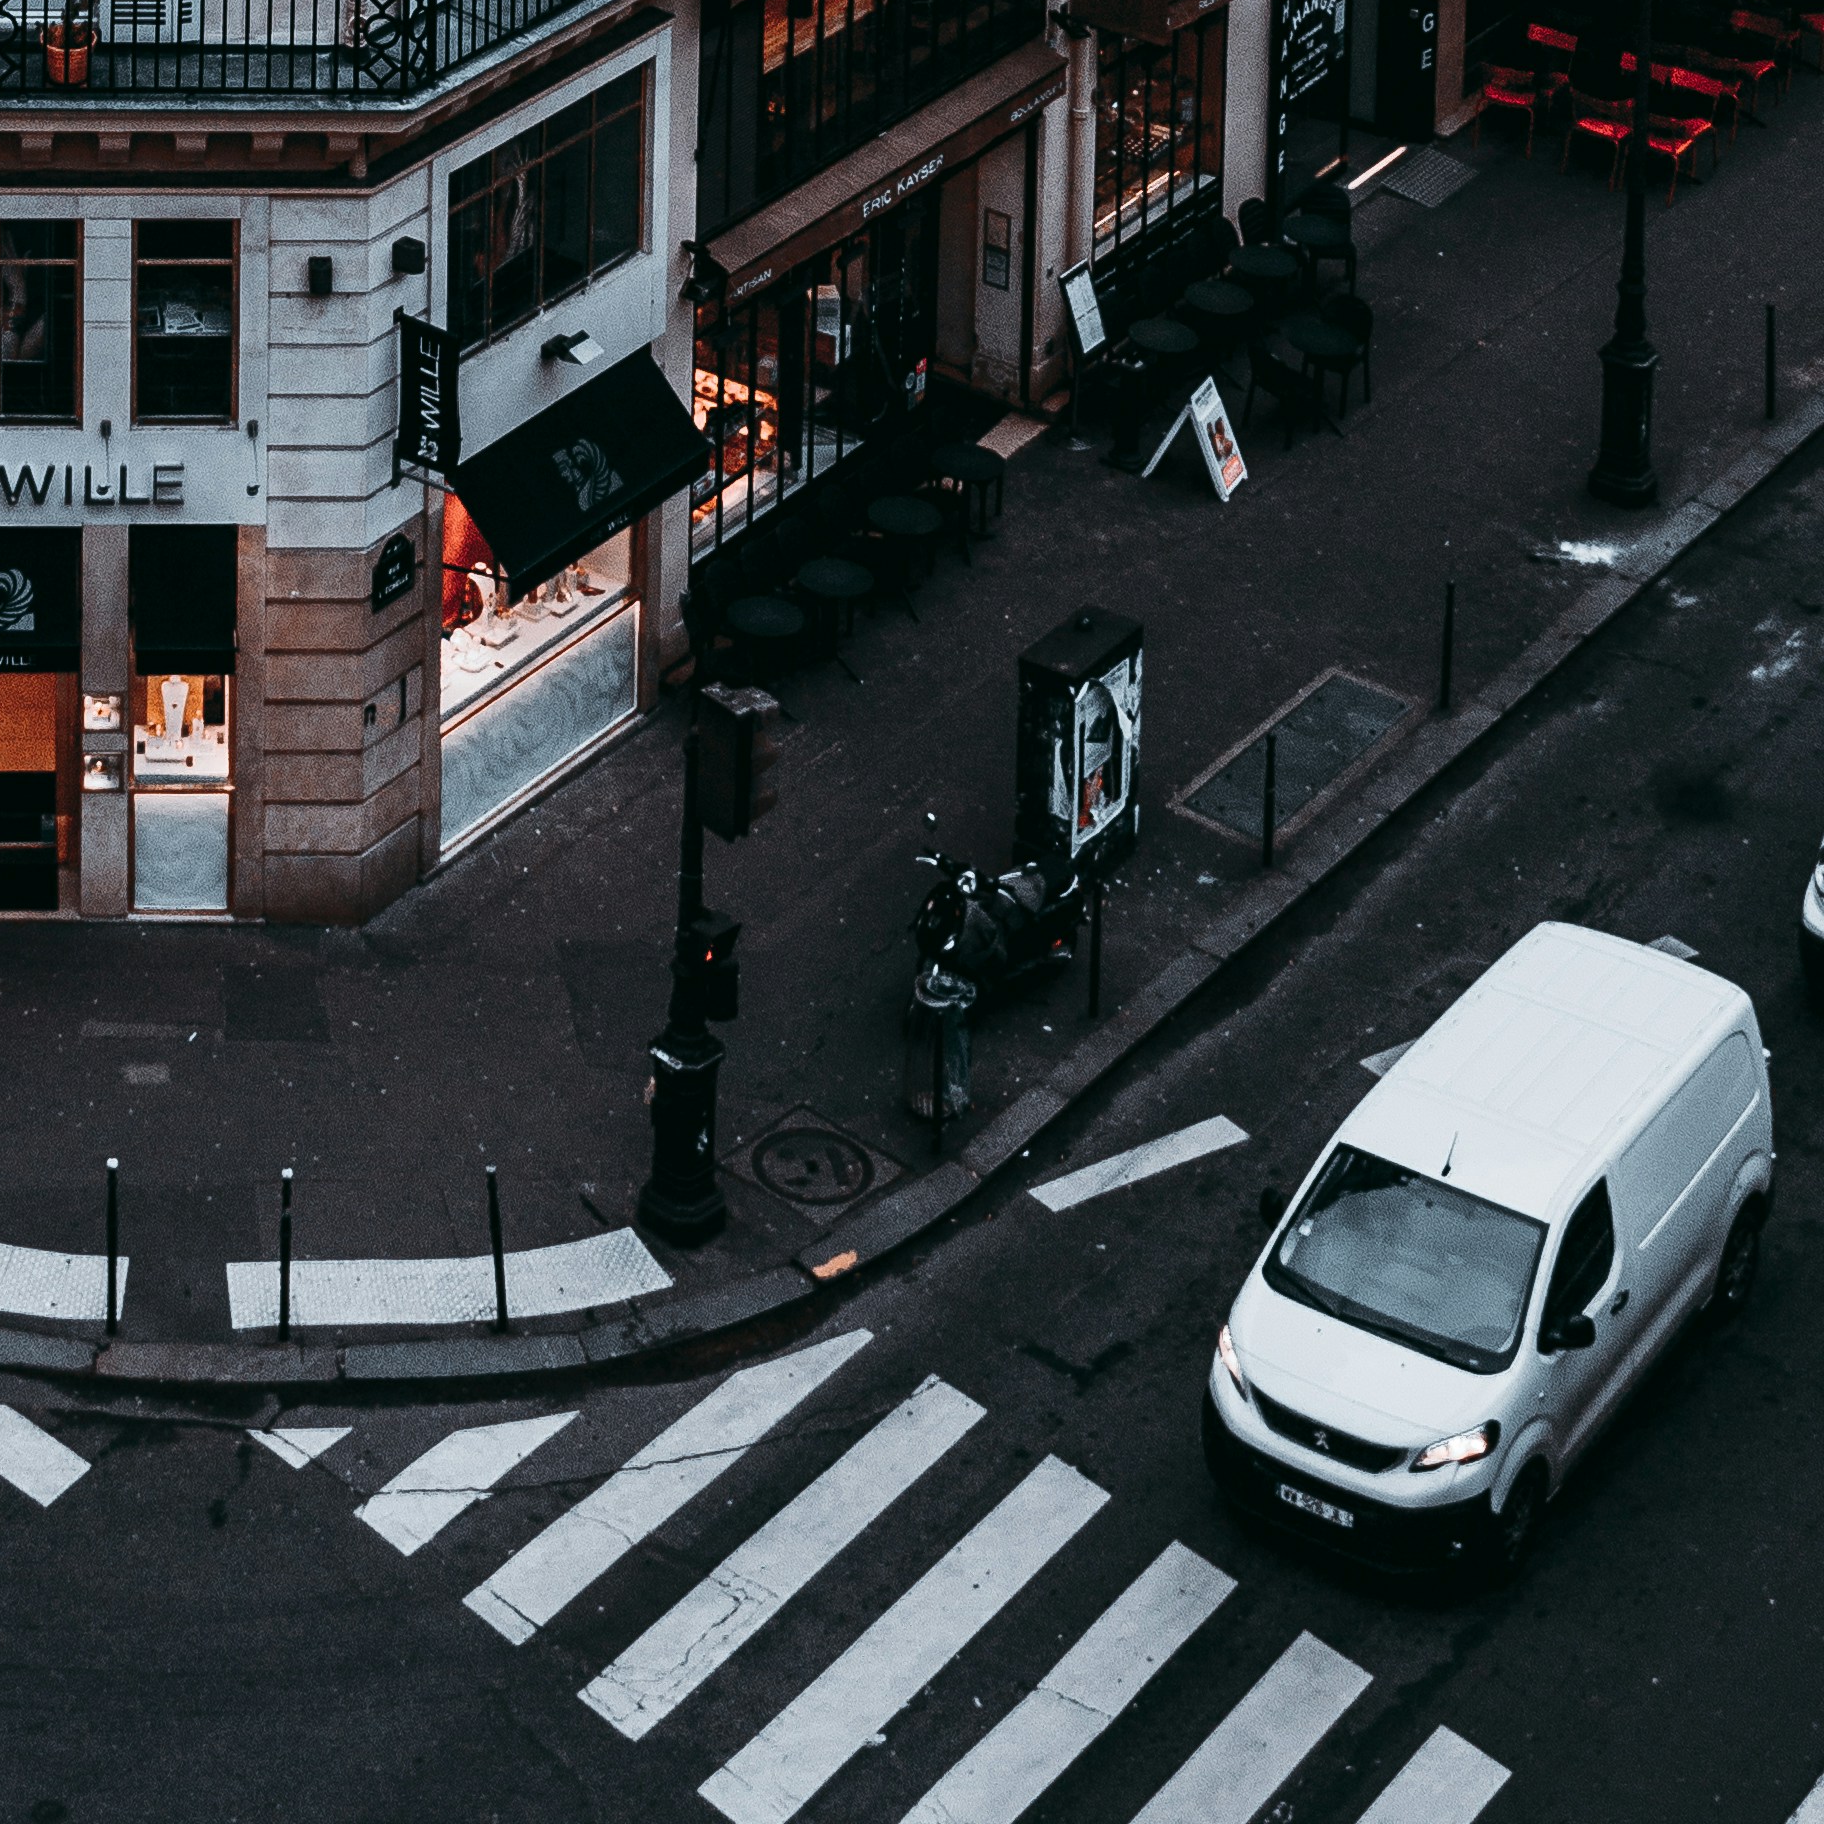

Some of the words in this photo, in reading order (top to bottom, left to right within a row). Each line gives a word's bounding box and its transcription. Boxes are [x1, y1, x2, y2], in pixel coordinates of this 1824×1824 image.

[862, 188, 892, 219] ERIC
[897, 153, 944, 196] KAYSER
[419, 335, 441, 430] WILLE
